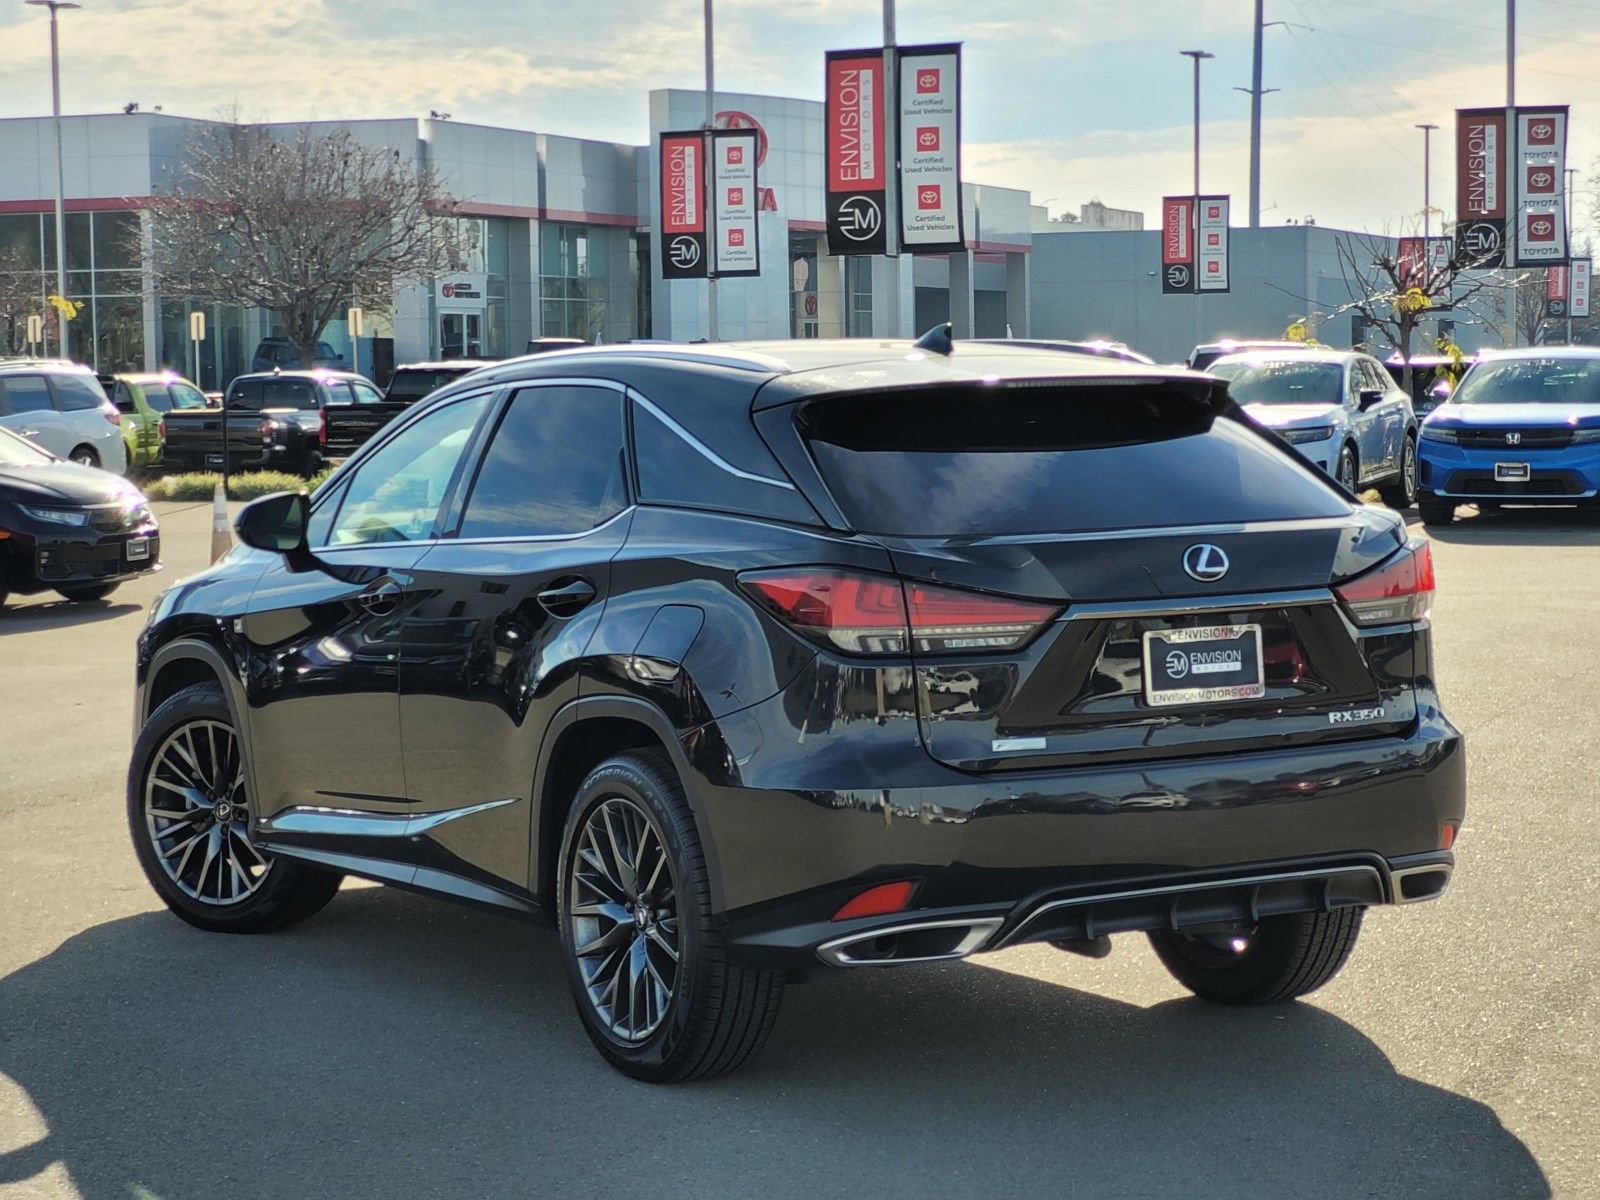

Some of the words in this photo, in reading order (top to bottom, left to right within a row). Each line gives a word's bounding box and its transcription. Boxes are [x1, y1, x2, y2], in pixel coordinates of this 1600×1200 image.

[912, 98, 944, 107] Certified
[904, 107, 922, 115] Used
[924, 107, 953, 115] Vehicles
[840, 69, 859, 181] ENVISION
[862, 78, 871, 170] MOTORS
[1523, 151, 1560, 159] TOYOTA
[913, 156, 944, 165] Certified
[904, 165, 923, 173] Used
[924, 165, 953, 173] Vehicles
[1468, 125, 1485, 212] ENVISION
[1487, 133, 1495, 204] MOTORS
[671, 145, 686, 226] ENVISION
[1523, 200, 1560, 208] TOYOTA
[915, 214, 946, 223] Certified
[907, 223, 925, 232] Used
[926, 223, 955, 231] Vehicles
[1169, 205, 1179, 259] ENVISION
[1523, 247, 1560, 256] TOYOTA
[1176, 627, 1228, 640] ENVISION
[1190, 649, 1242, 665] ENVISION
